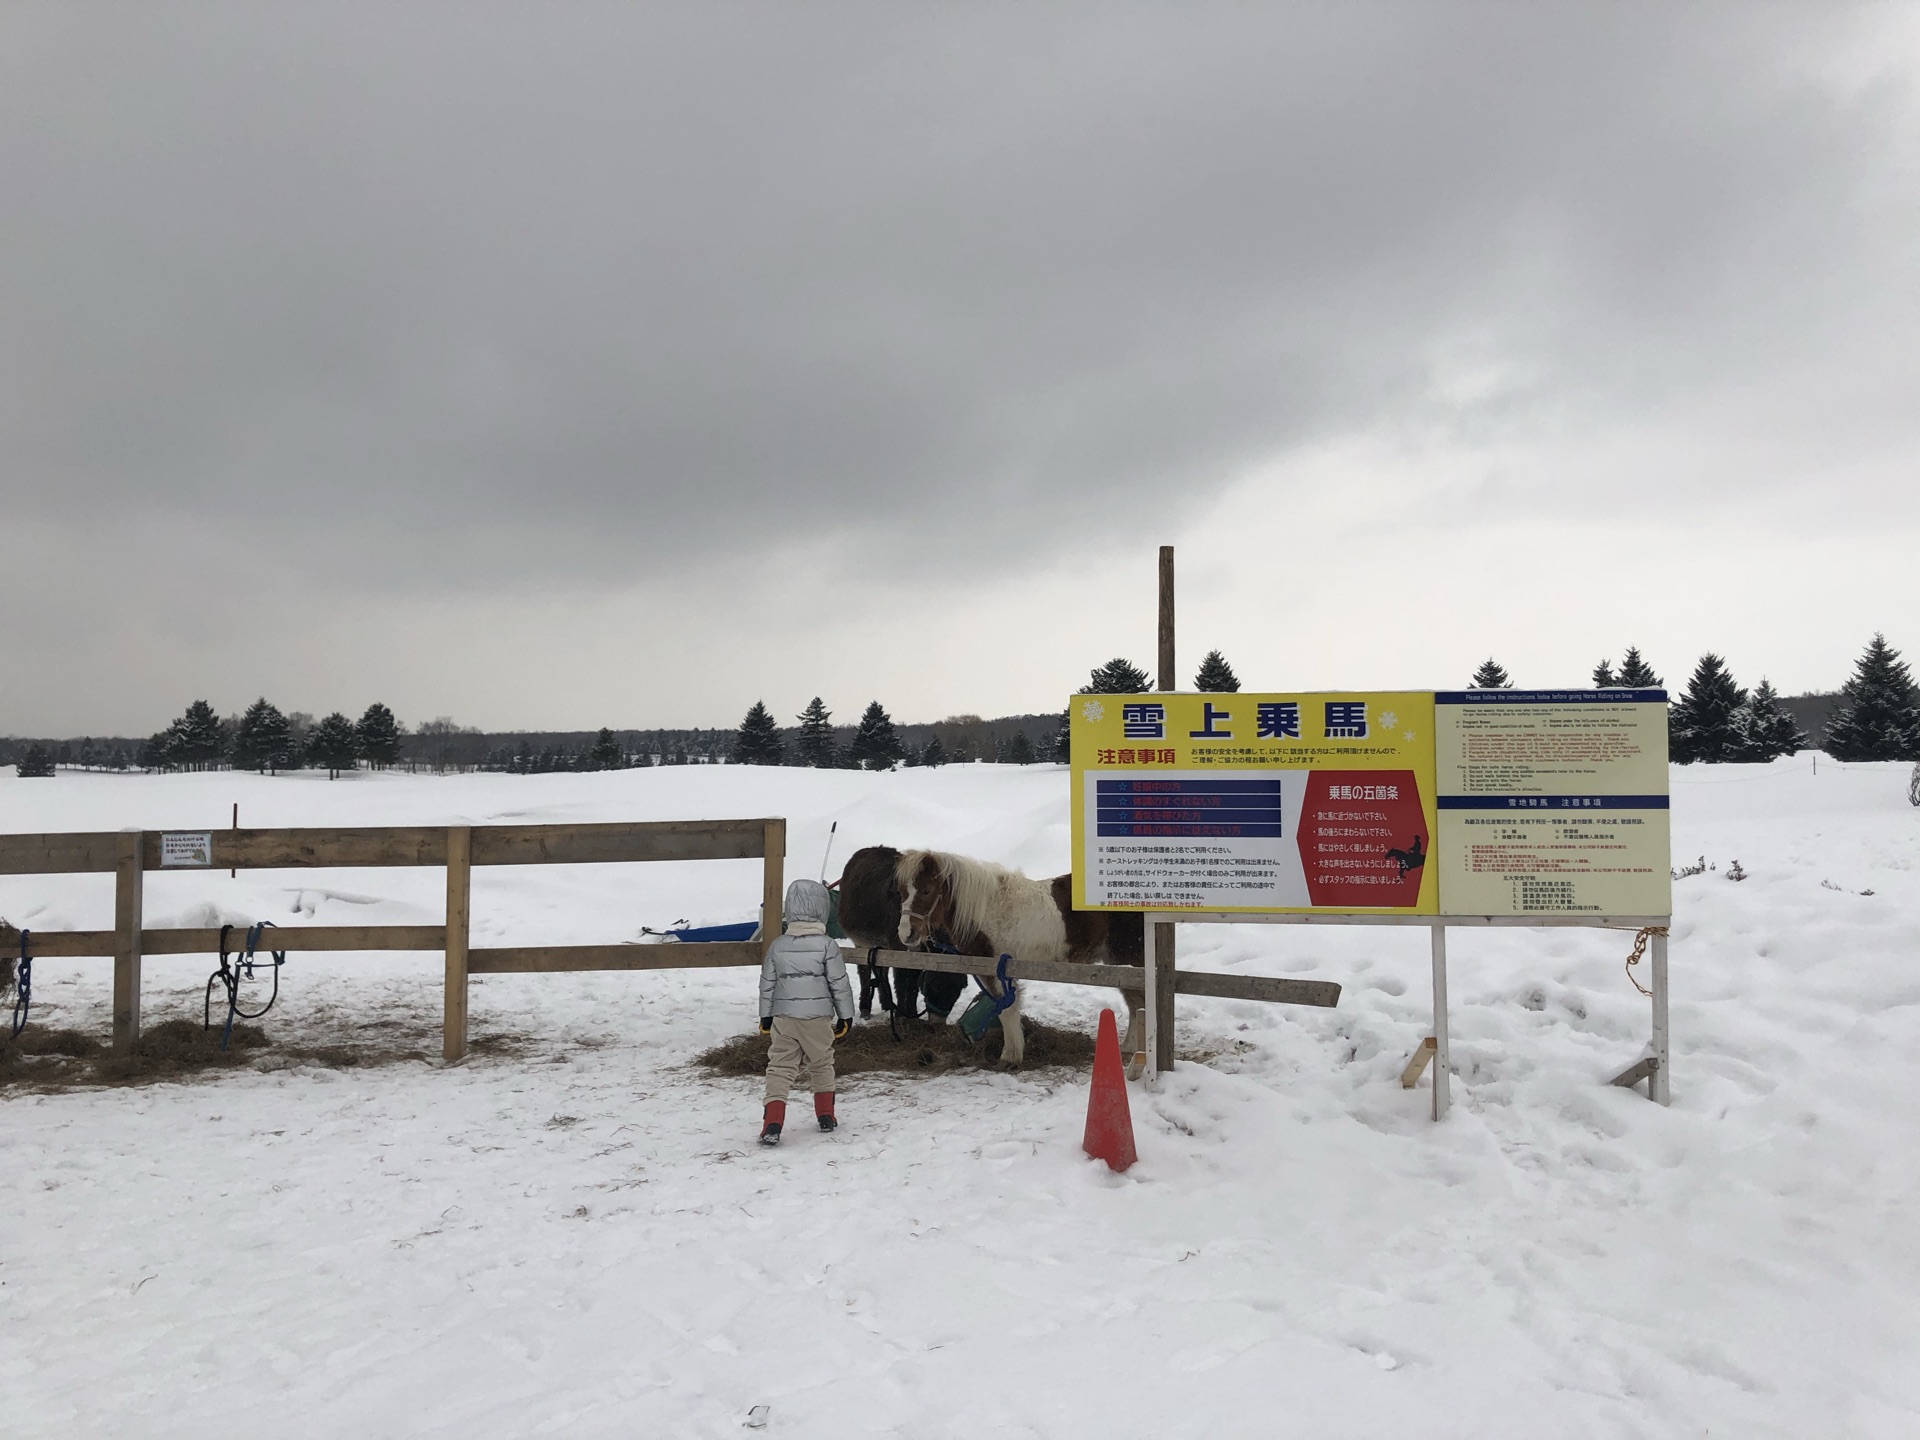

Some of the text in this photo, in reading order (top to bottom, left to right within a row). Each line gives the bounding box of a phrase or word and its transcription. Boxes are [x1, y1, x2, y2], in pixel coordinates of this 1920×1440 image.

[1122, 702, 1367, 738] 雪上乗馬
[1097, 748, 1176, 764] 注意事項
[1329, 786, 1398, 800] 乗馬の五箇条
[1318, 812, 1388, 821] 急に馬に近づかないで下さい。
[1318, 828, 1392, 837] 馬の後ろにまわらないで下さい。
[1318, 844, 1388, 852] 馬にはやさしく接しましょう。
[1318, 860, 1409, 868] 大きな声を出さないようにしましょう。
[1319, 875, 1404, 885] 必ずスタッフの指示に従いましょう。
